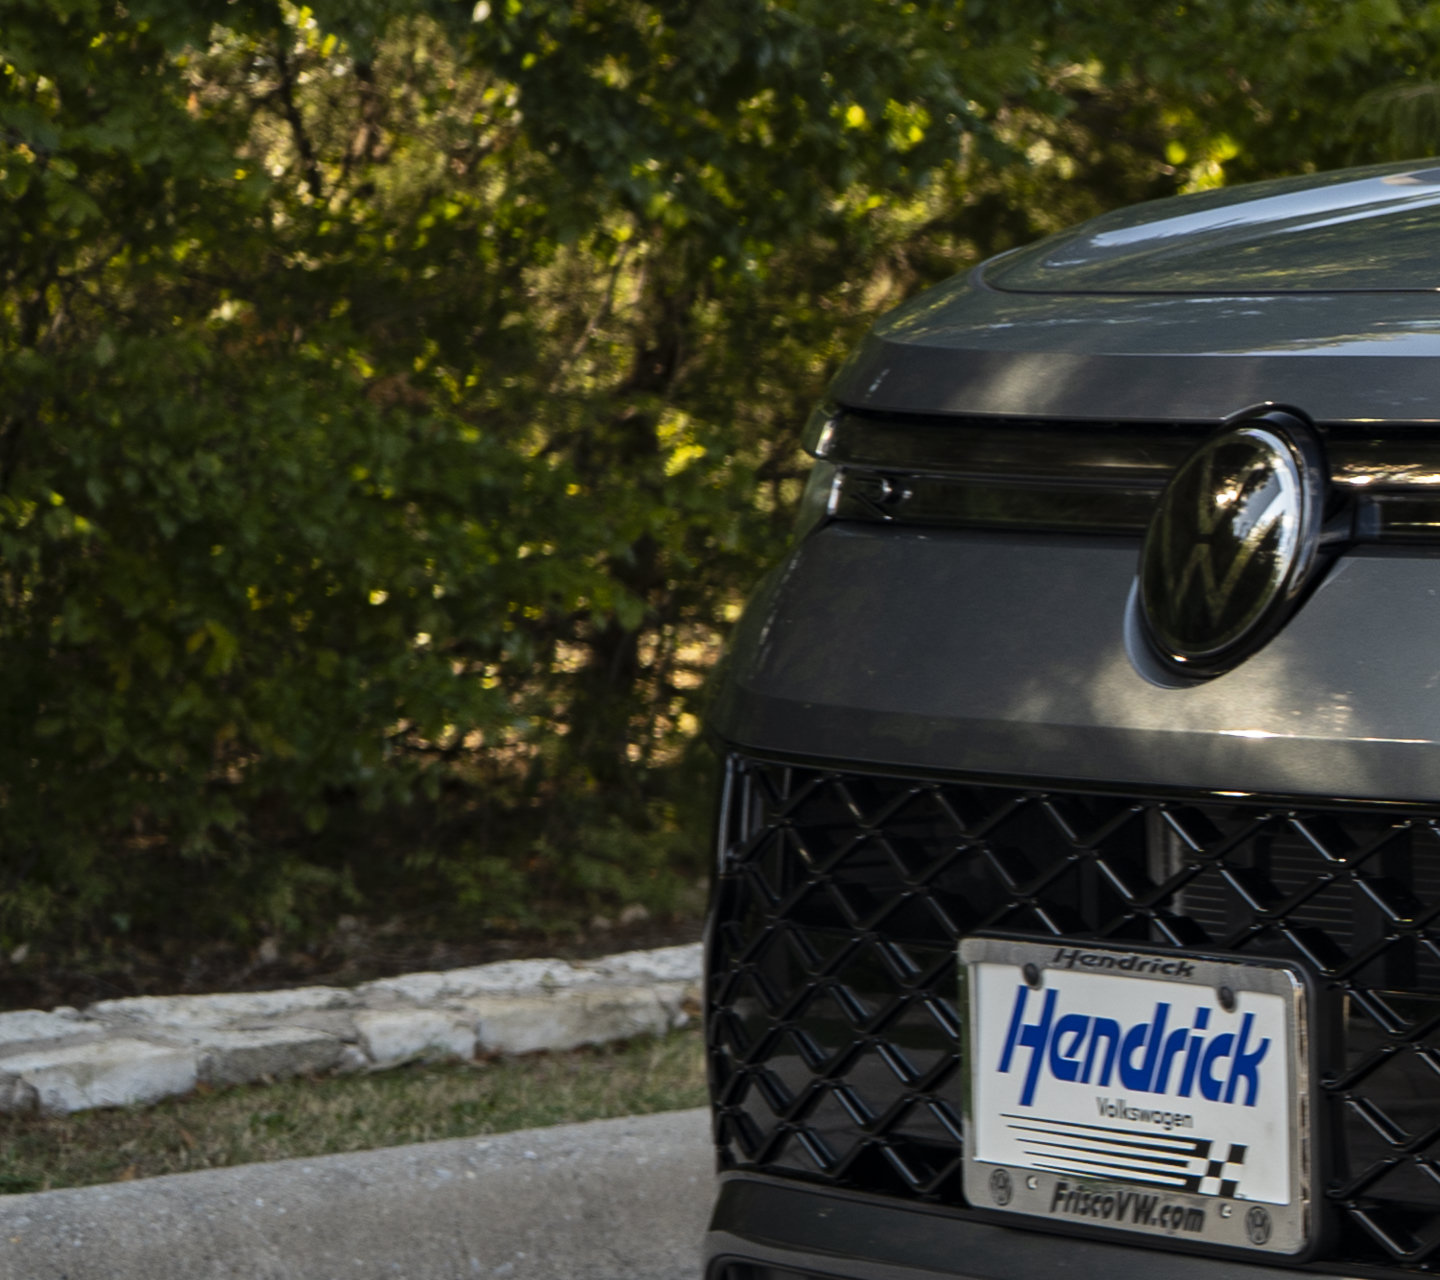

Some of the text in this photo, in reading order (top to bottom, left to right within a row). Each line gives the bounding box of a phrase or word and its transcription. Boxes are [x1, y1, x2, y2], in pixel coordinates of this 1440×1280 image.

[1052, 947, 1196, 978] Hendrick
[996, 984, 1272, 1107] Hendrick
[1096, 1096, 1194, 1131] Volkswagen
[1050, 1180, 1207, 1233] FriscoVW.com
